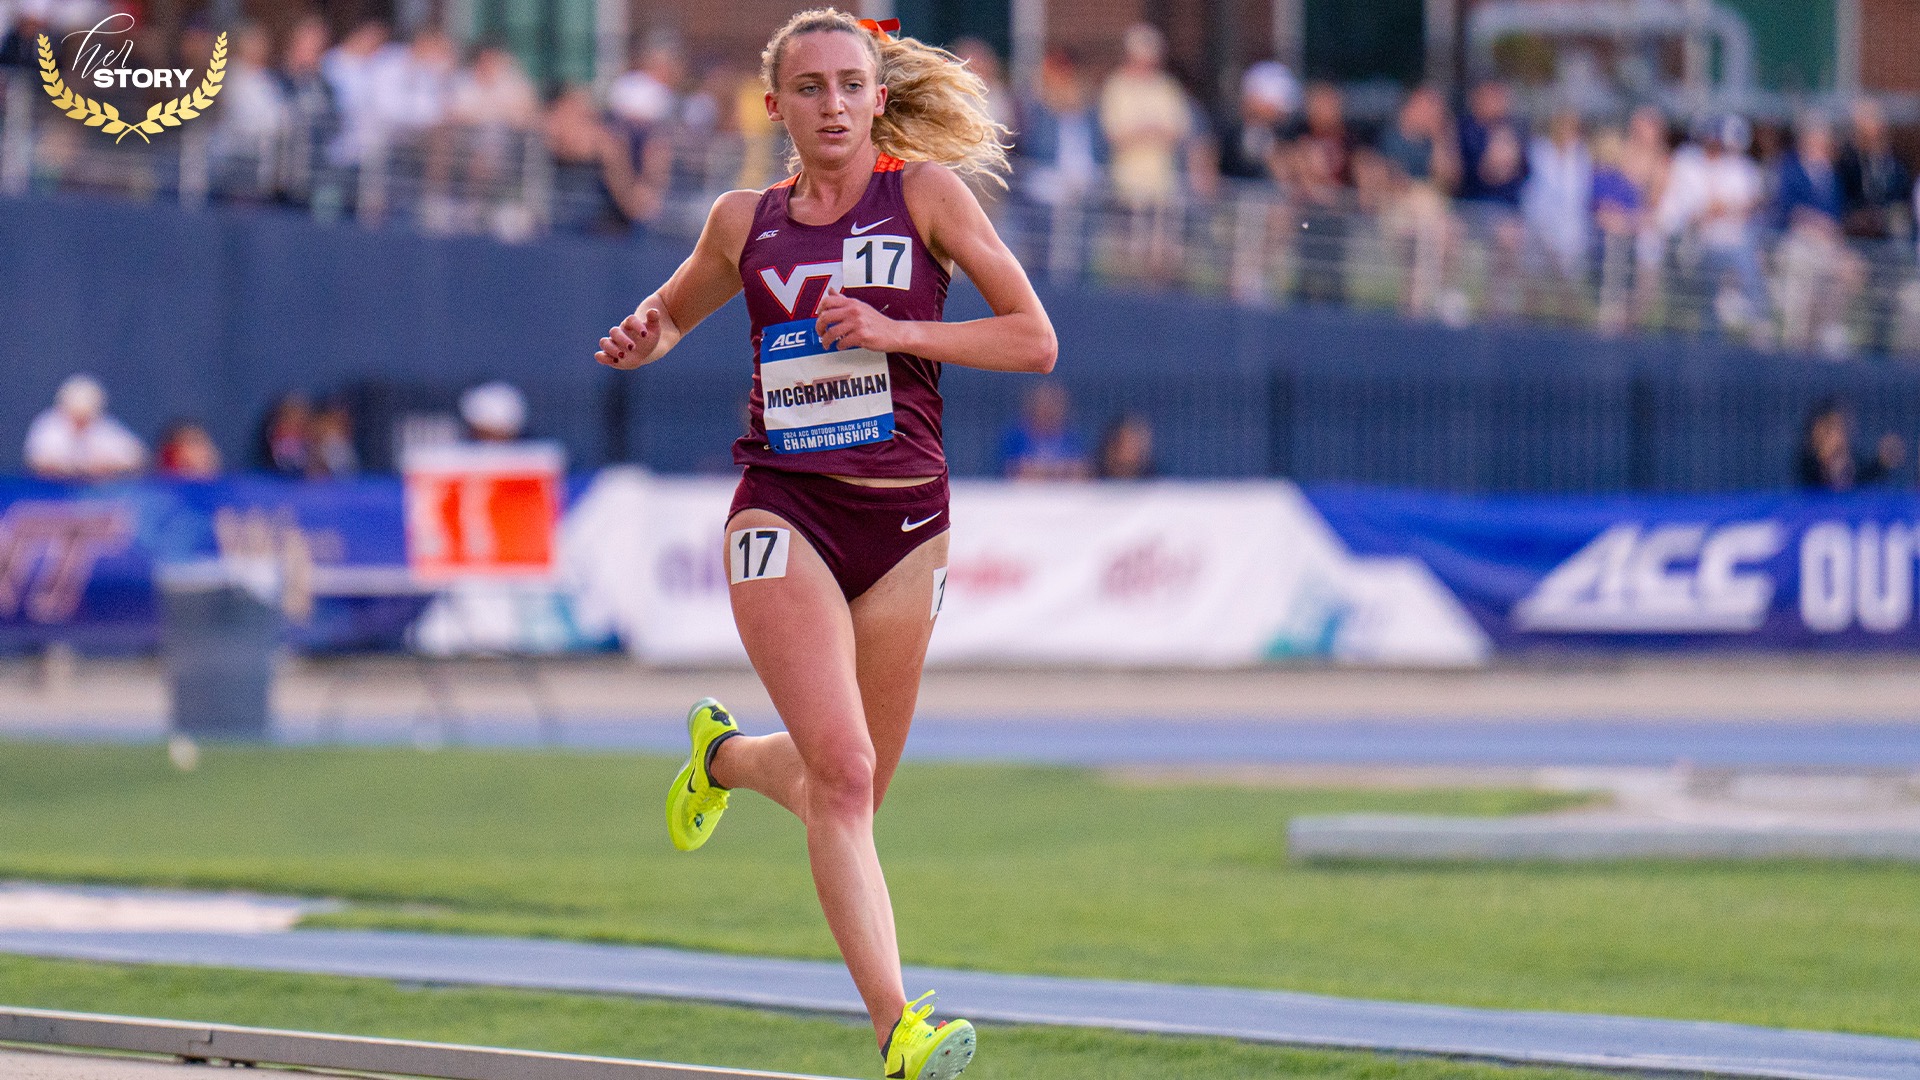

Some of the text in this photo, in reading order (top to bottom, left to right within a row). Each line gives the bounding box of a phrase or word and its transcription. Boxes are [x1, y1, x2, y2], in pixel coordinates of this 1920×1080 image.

[856, 241, 906, 285] 17
[769, 331, 807, 351] ACC
[767, 373, 887, 409] MCGRANAHAN
[783, 426, 880, 451] CHAMPIONSHIPS
[799, 429, 809, 437] ACC
[811, 426, 836, 436] OUTDOOR
[837, 423, 855, 432] TRACK
[862, 419, 878, 428] FIELD
[738, 530, 778, 578] 17
[1511, 520, 1920, 633] ACC OU
